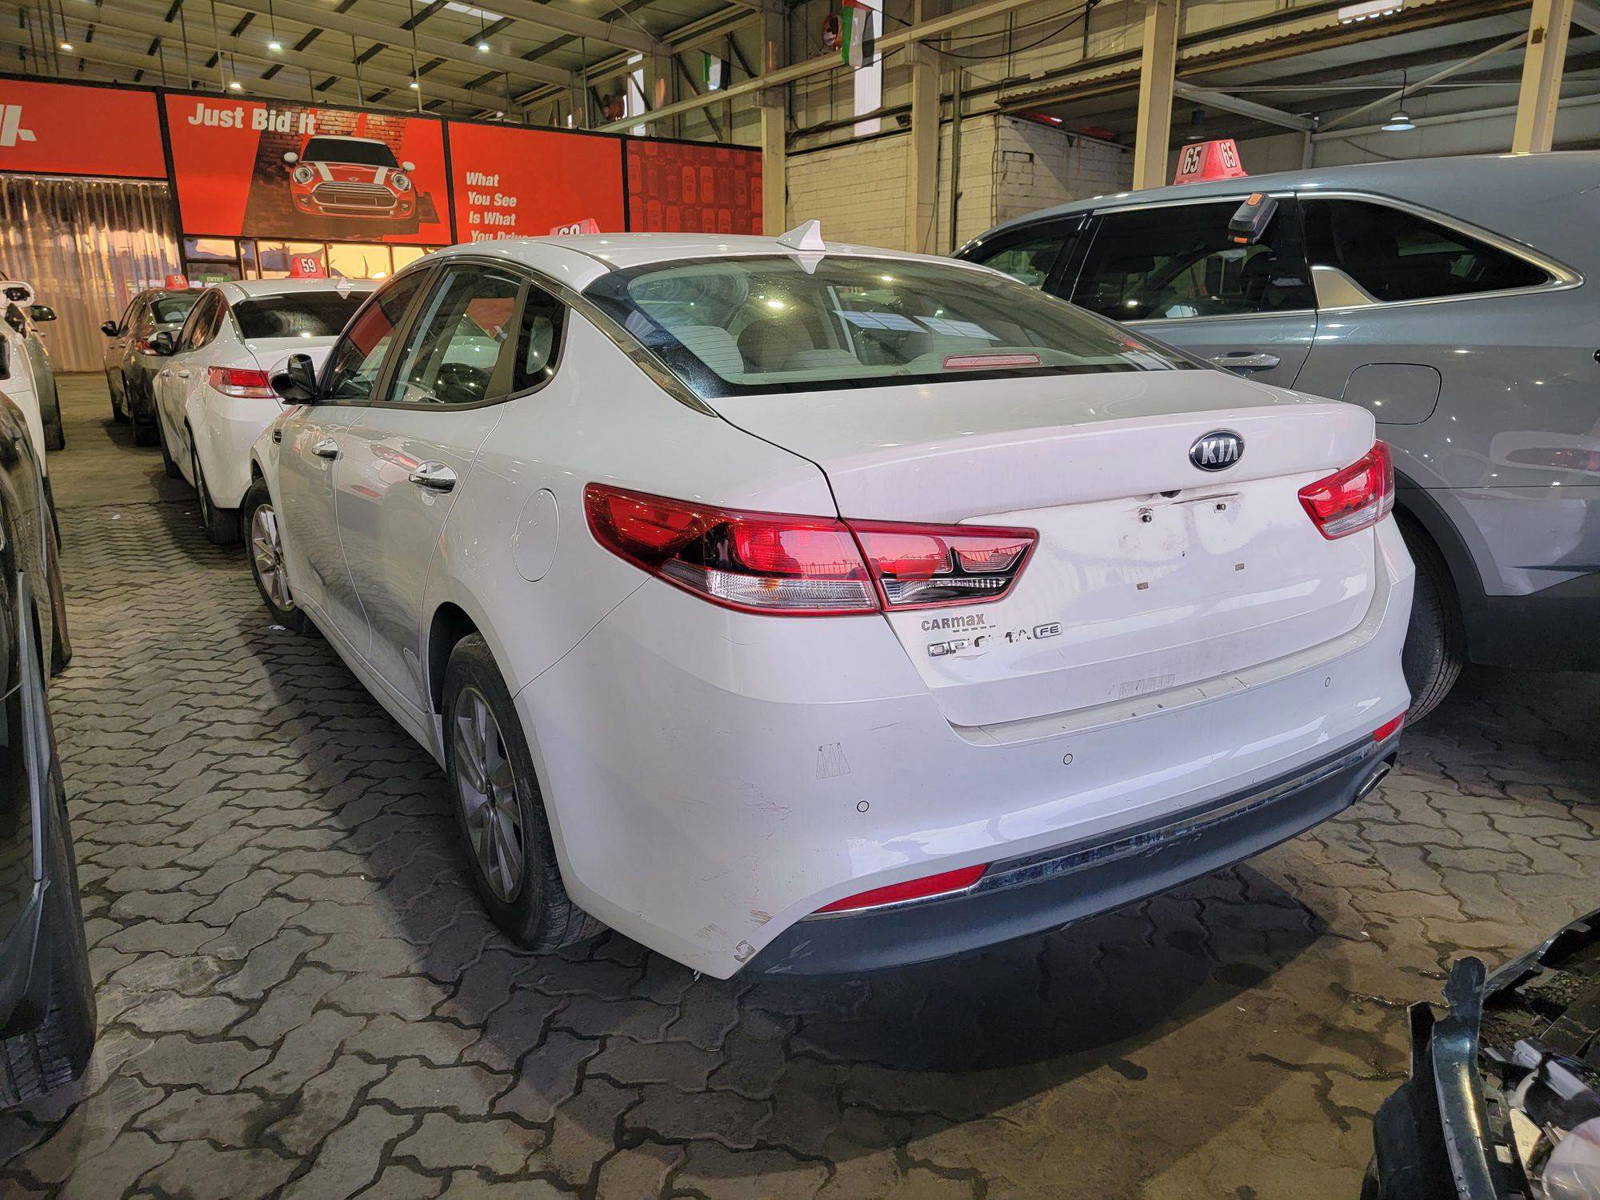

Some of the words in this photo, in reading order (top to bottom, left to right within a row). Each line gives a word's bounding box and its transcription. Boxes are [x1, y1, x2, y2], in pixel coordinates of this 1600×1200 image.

[188, 103, 244, 128] Just
[251, 108, 292, 133] Bid
[299, 112, 317, 135] It
[1182, 146, 1202, 174] 65
[1220, 142, 1236, 168] 65
[466, 172, 500, 187] What
[468, 191, 491, 206] You
[493, 192, 517, 207] See
[469, 211, 481, 224] Is
[484, 211, 516, 226] What
[471, 230, 494, 242] You
[496, 231, 529, 241] Dri
[300, 257, 318, 273] 59
[1201, 438, 1239, 464] KIA
[1040, 625, 1060, 636] FE
